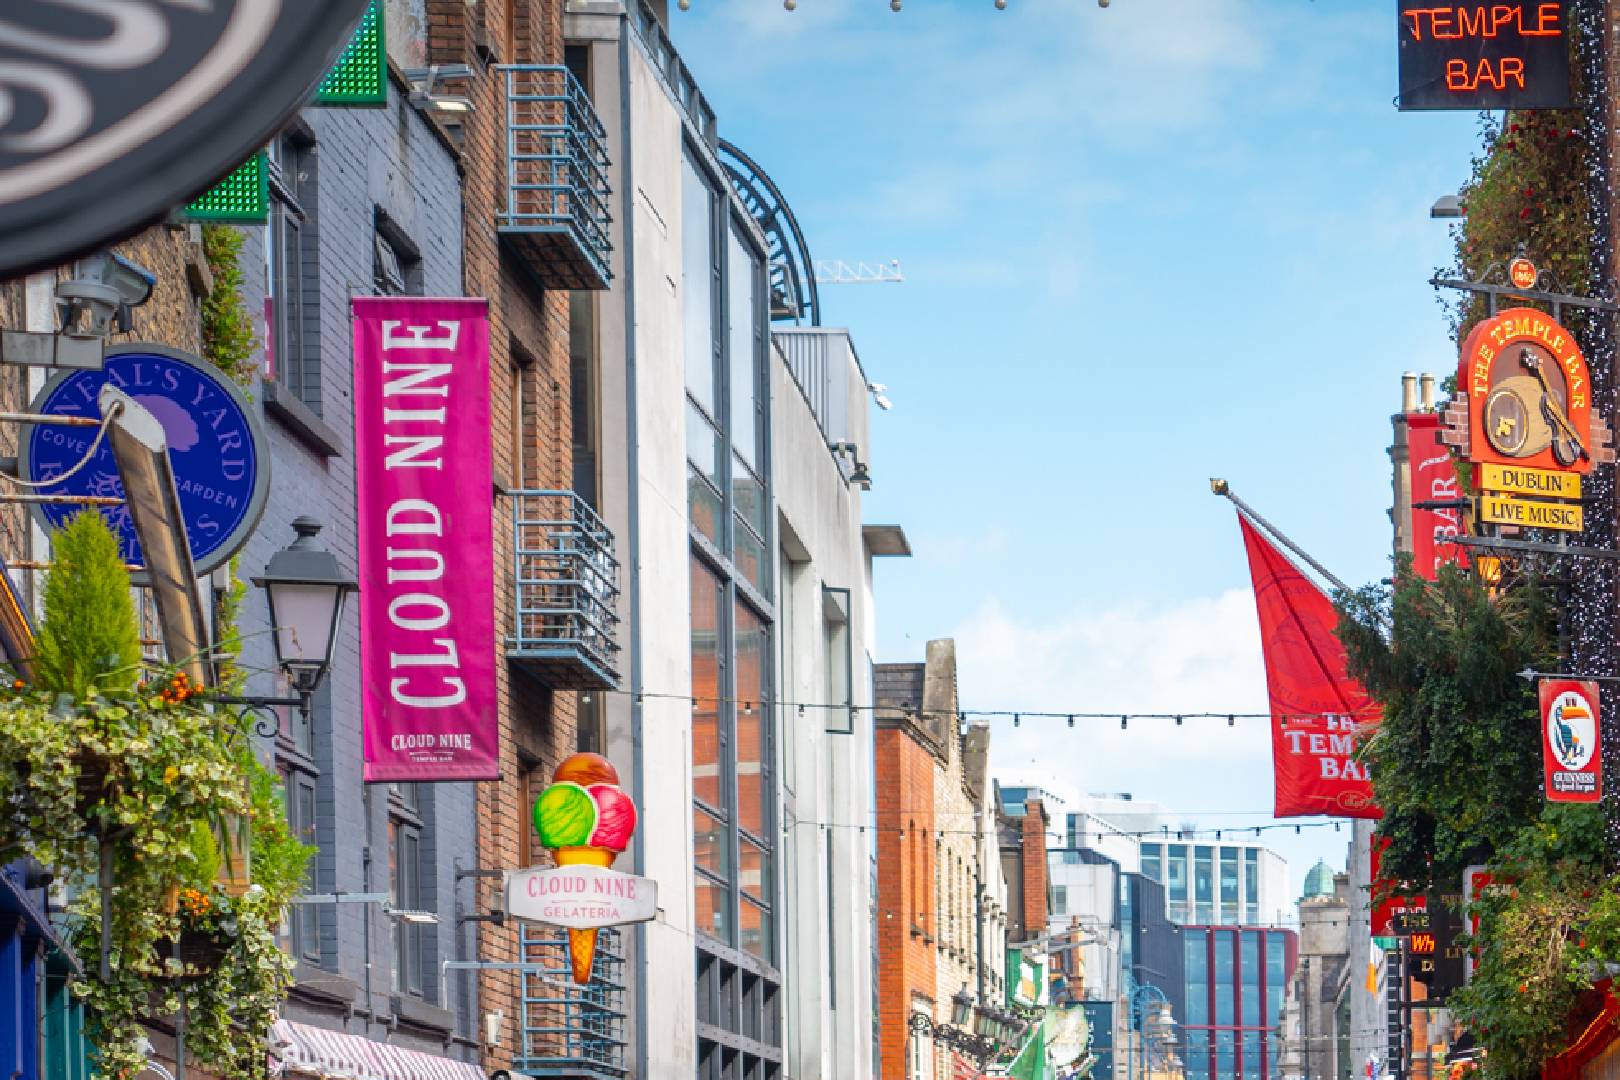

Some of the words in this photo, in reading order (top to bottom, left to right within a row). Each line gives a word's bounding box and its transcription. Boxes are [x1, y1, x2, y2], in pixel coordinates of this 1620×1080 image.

[1404, 3, 1562, 41] TEMPLE
[1446, 57, 1525, 91] BAR
[1474, 344, 1495, 398] THE
[1490, 317, 1566, 354] TEMPLE
[1565, 355, 1586, 410] BAR
[381, 319, 461, 471] NINE
[191, 383, 246, 482] YARD
[1502, 469, 1562, 491] DUBLIN
[1490, 502, 1524, 520] LIVE
[1528, 505, 1575, 525] MUSIC
[385, 497, 468, 709] CLOUD
[391, 734, 436, 751] CLOUD
[440, 734, 472, 751] NINE
[527, 875, 587, 898] CLOUD
[594, 878, 637, 900] NINE
[543, 906, 622, 920] GELATERIA
